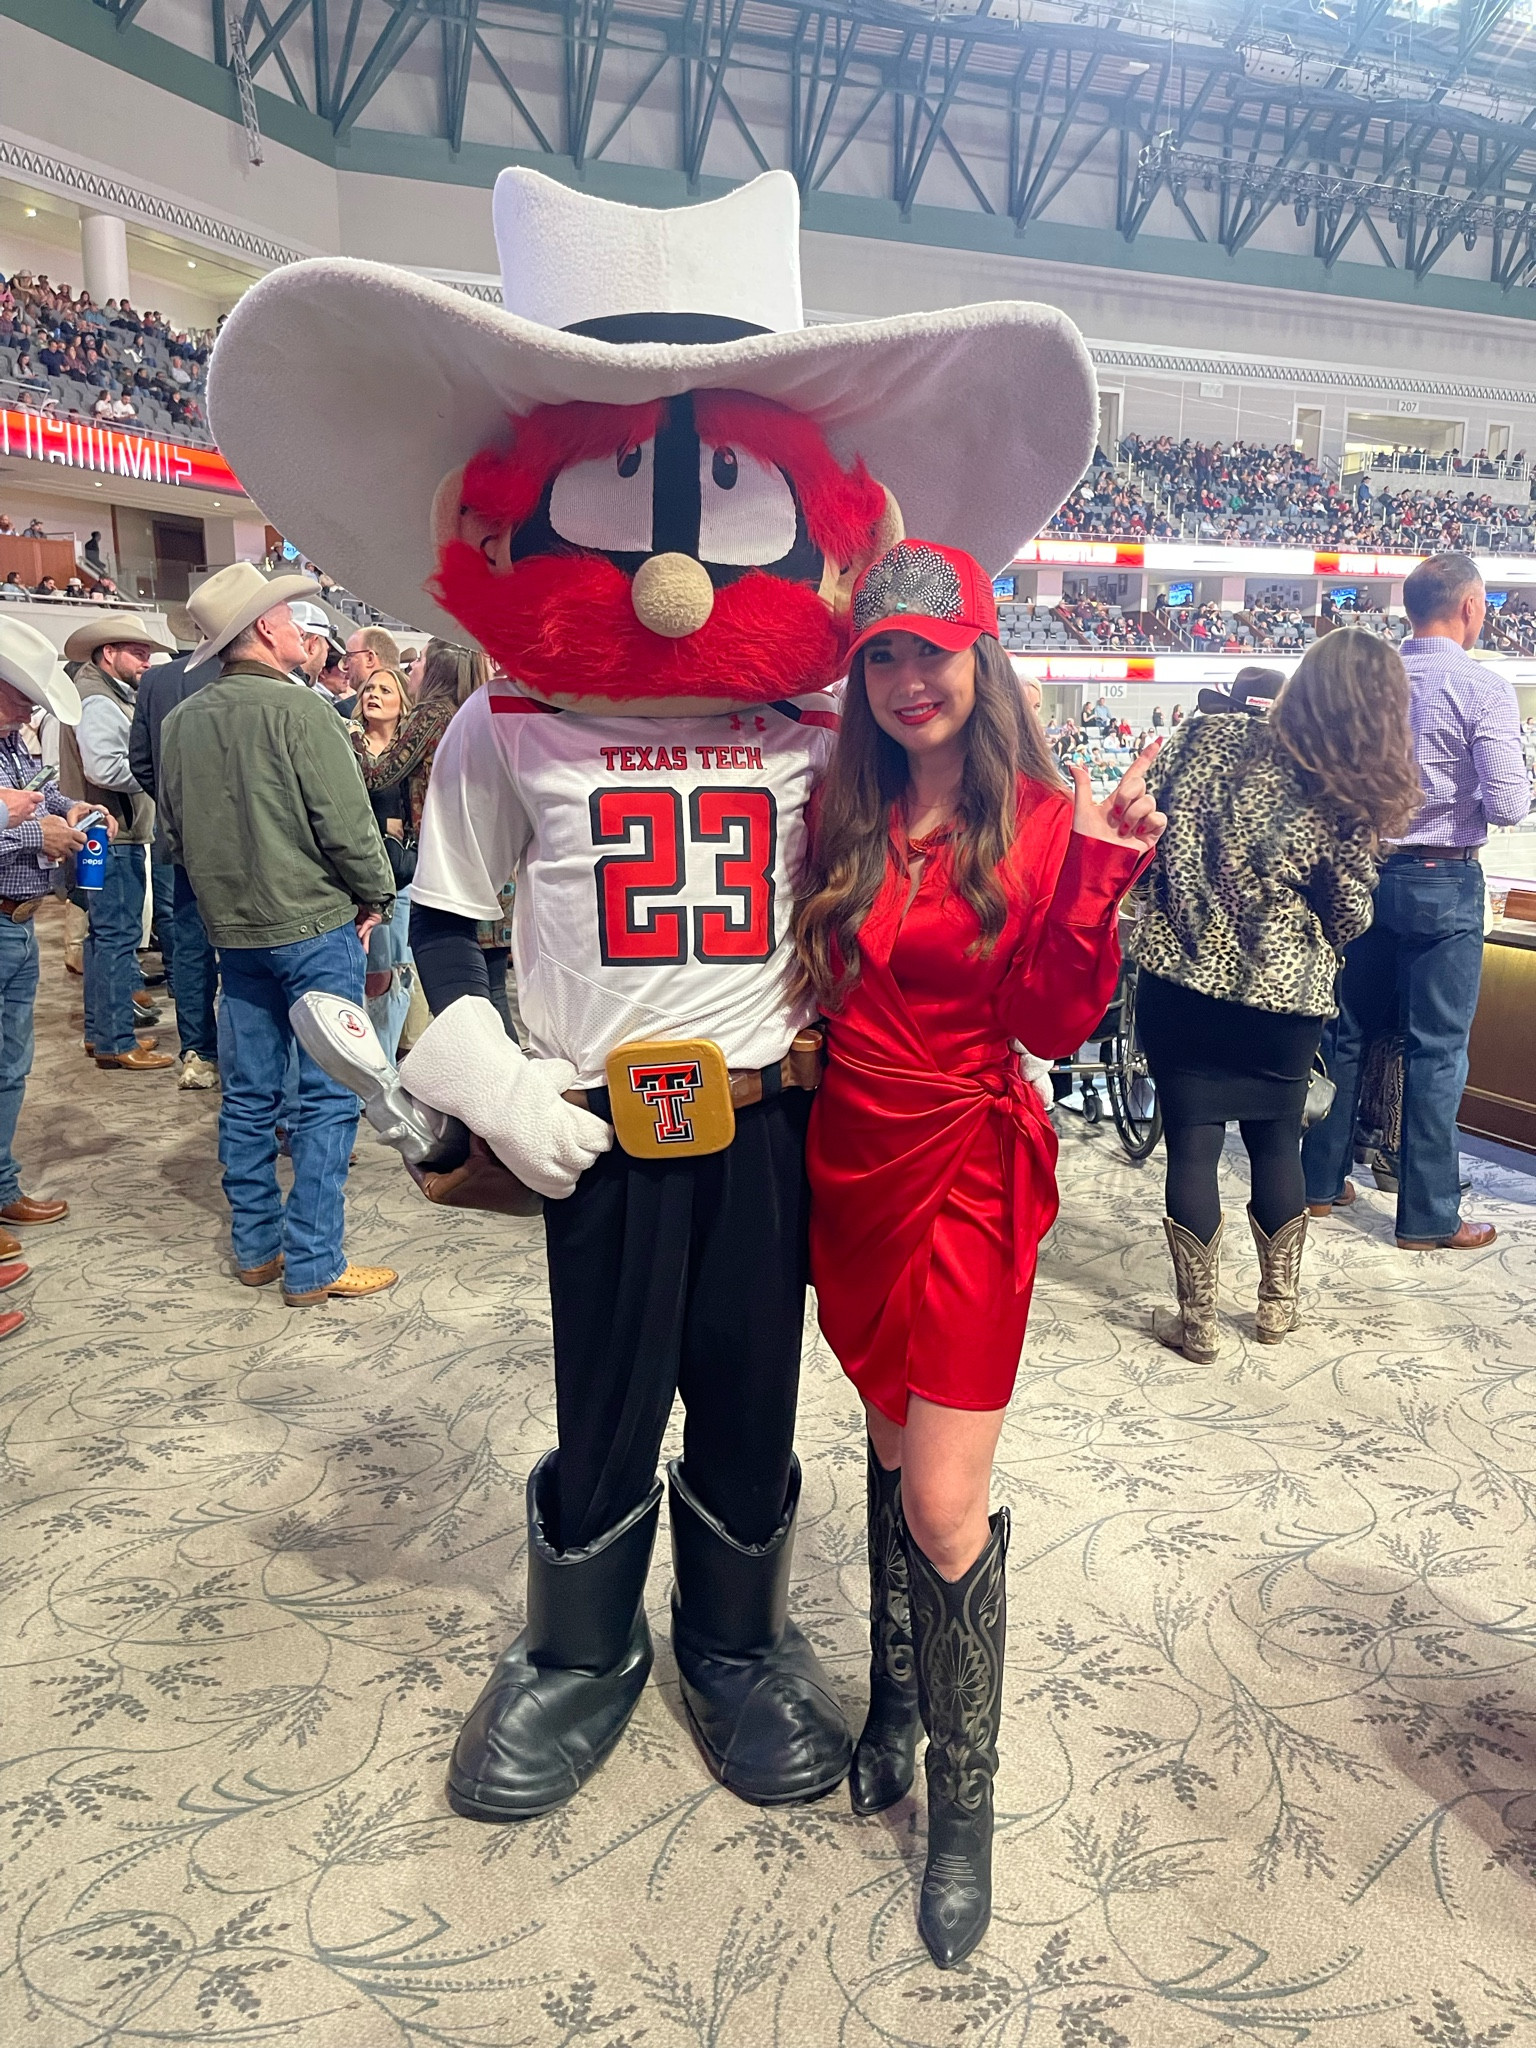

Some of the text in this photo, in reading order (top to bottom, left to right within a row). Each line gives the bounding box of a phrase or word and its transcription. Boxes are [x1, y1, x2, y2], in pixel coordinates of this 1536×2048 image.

[1400, 401, 1417, 412] 207
[1104, 685, 1124, 697] 105
[600, 746, 764, 771] TEXAS TECH
[589, 786, 777, 967] 23
